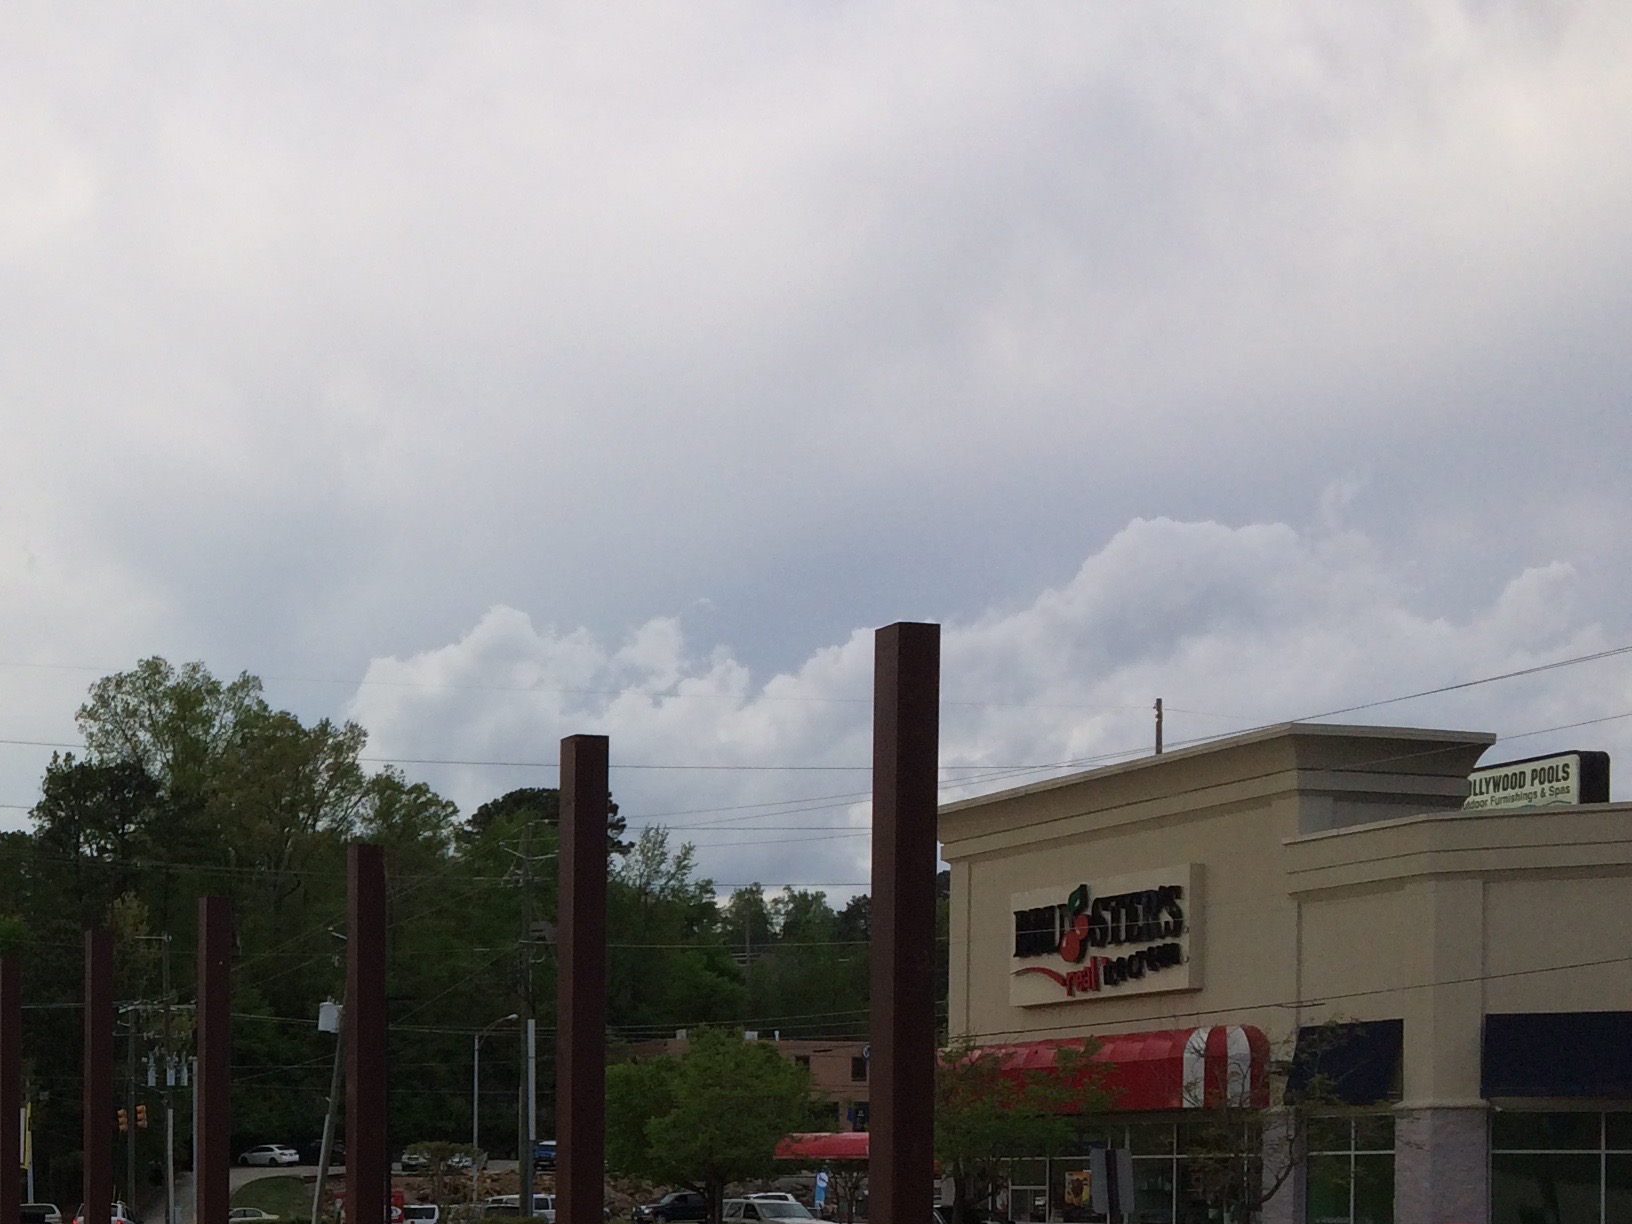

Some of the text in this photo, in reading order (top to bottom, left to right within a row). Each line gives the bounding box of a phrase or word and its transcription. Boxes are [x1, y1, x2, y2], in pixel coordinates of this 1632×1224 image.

[1470, 763, 1570, 796] LLYWOOD POOLS
[1490, 790, 1538, 805] Furnishings
[1540, 787, 1547, 799] &
[1548, 785, 1570, 798] Spas
[1066, 956, 1100, 996] real
